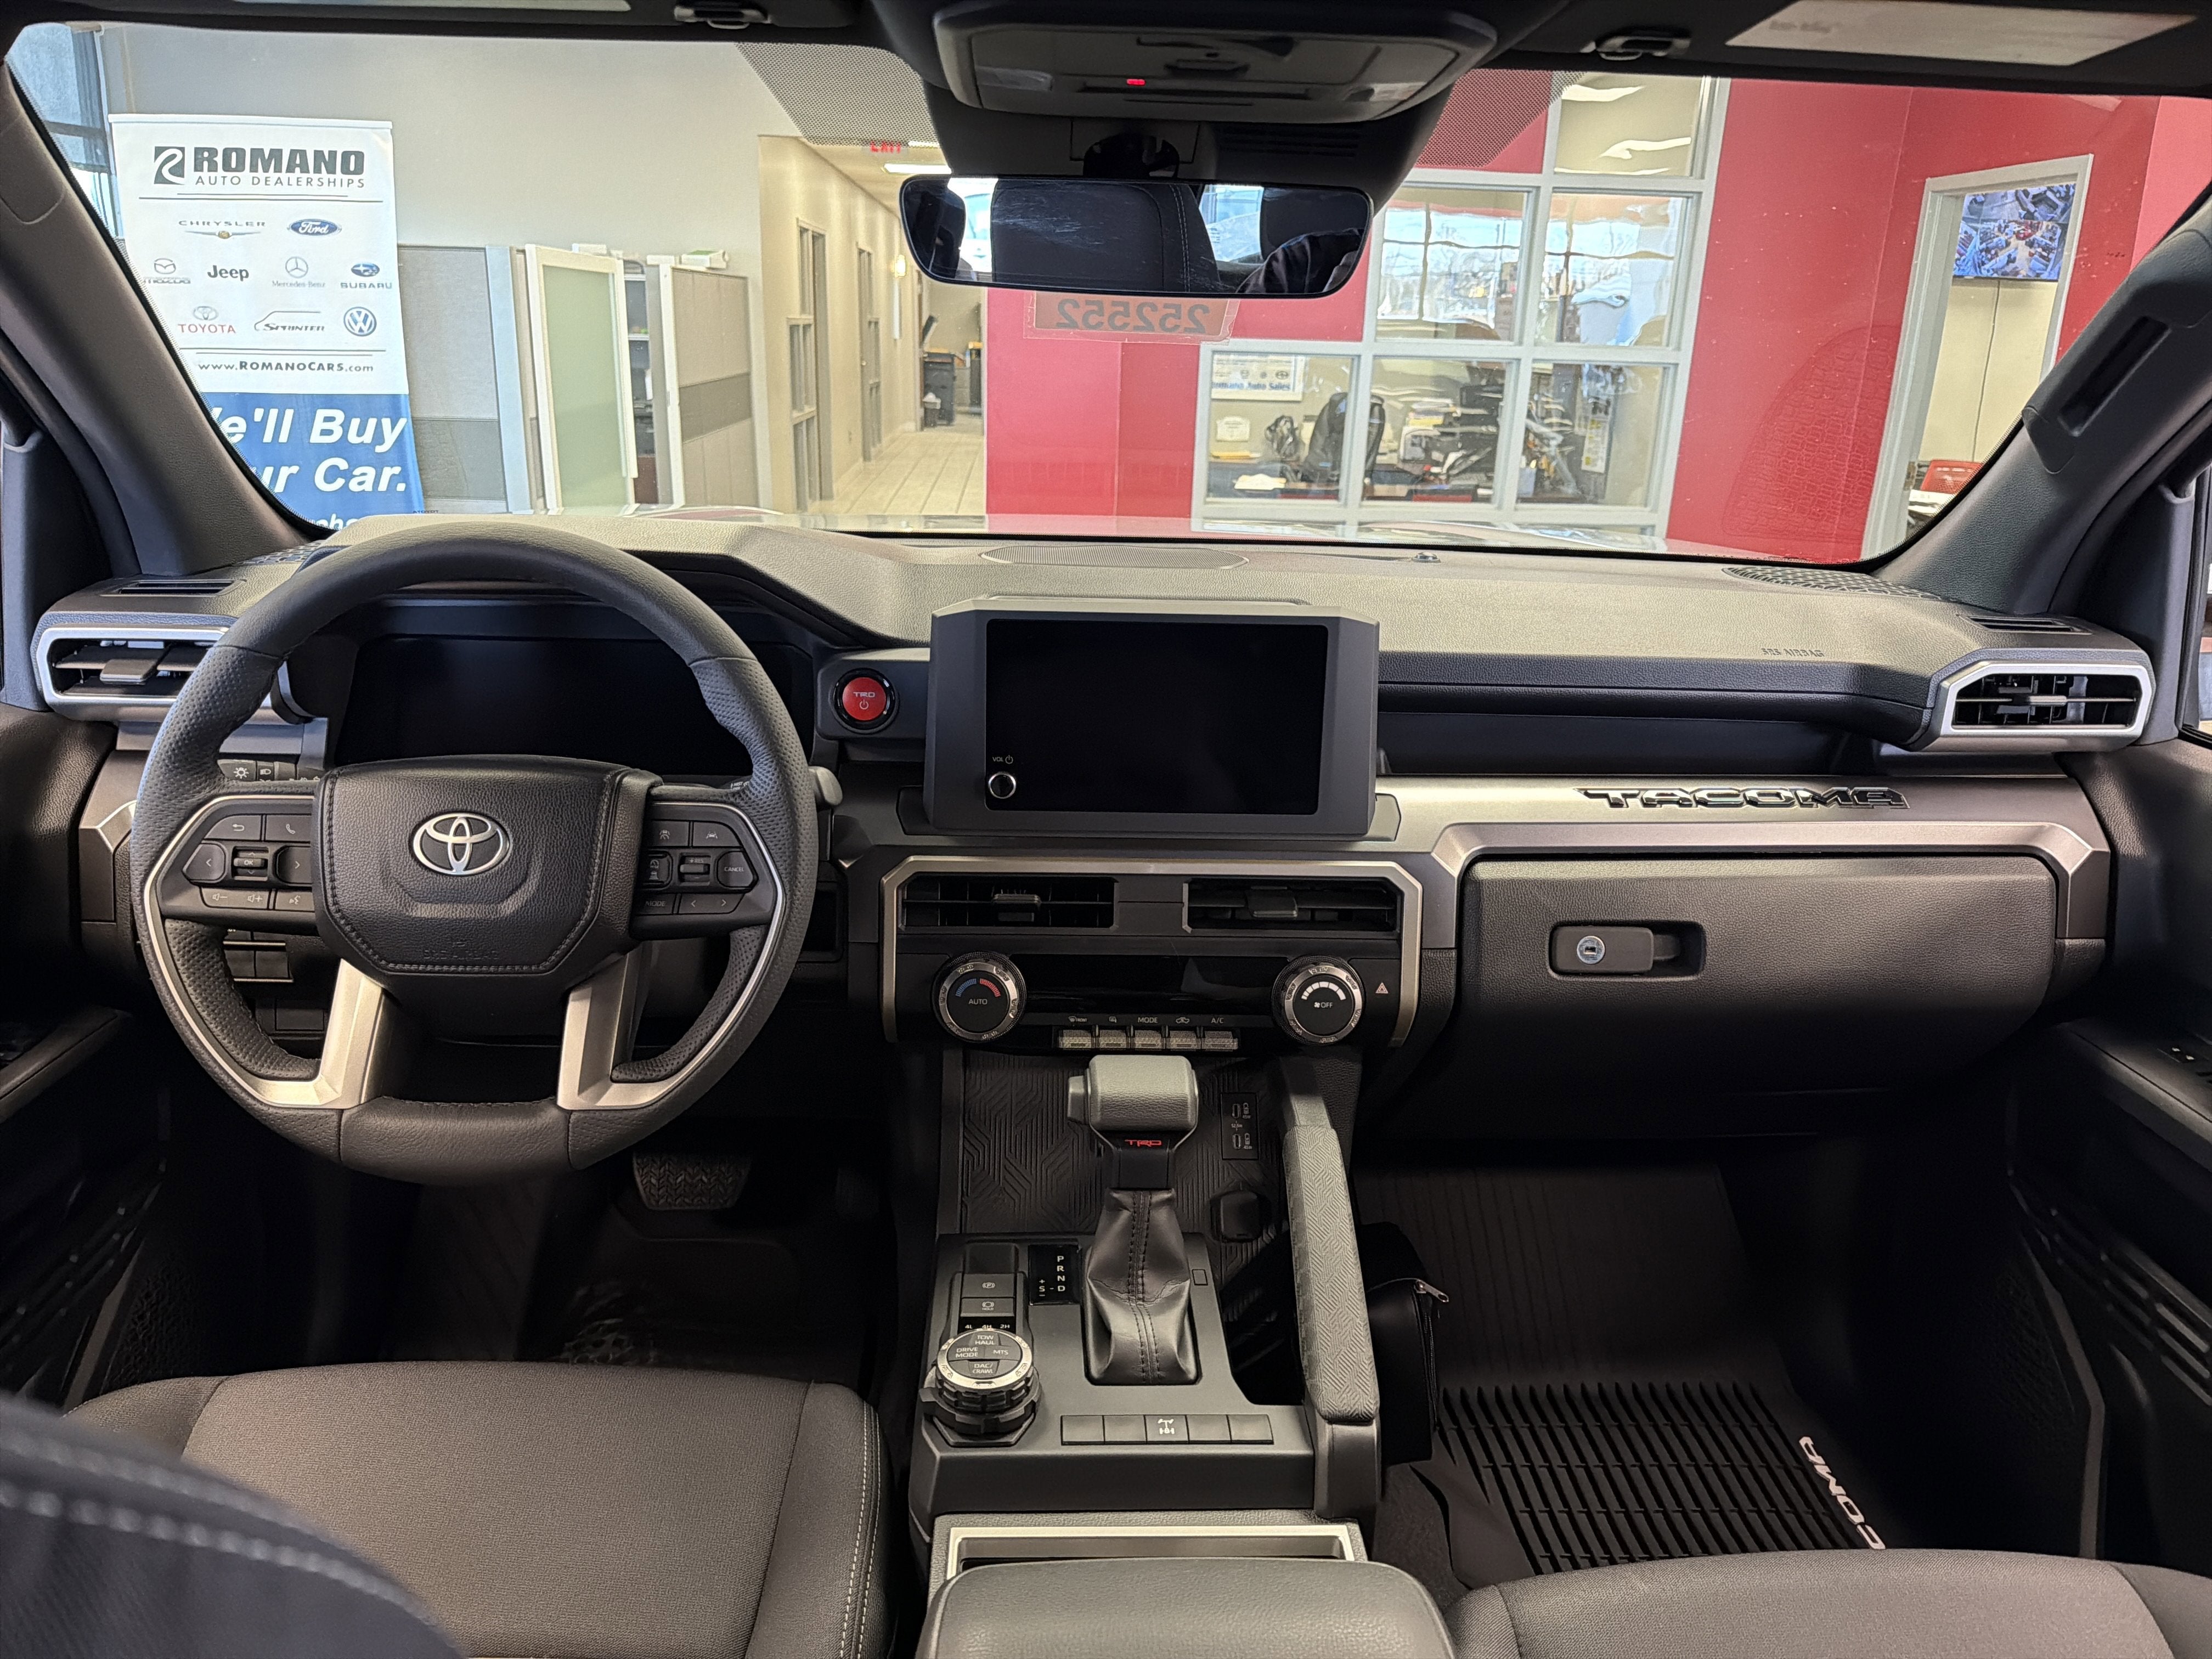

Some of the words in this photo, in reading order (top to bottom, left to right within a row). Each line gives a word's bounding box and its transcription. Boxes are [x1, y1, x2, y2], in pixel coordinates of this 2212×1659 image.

[194, 146, 365, 176] ROMANO
[195, 176, 241, 187] AUTO
[251, 176, 364, 188] DEALERSHIPS
[298, 222, 329, 235] Ford
[207, 266, 249, 281] Jeep
[178, 324, 236, 334] TOYOTA
[212, 407, 295, 443] e'll
[309, 409, 408, 453] Buy
[314, 458, 407, 492] Car.
[1573, 788, 1910, 809] TACOMA
[1125, 1139, 1162, 1148] TRD
[1799, 1436, 1886, 1549] COMA
